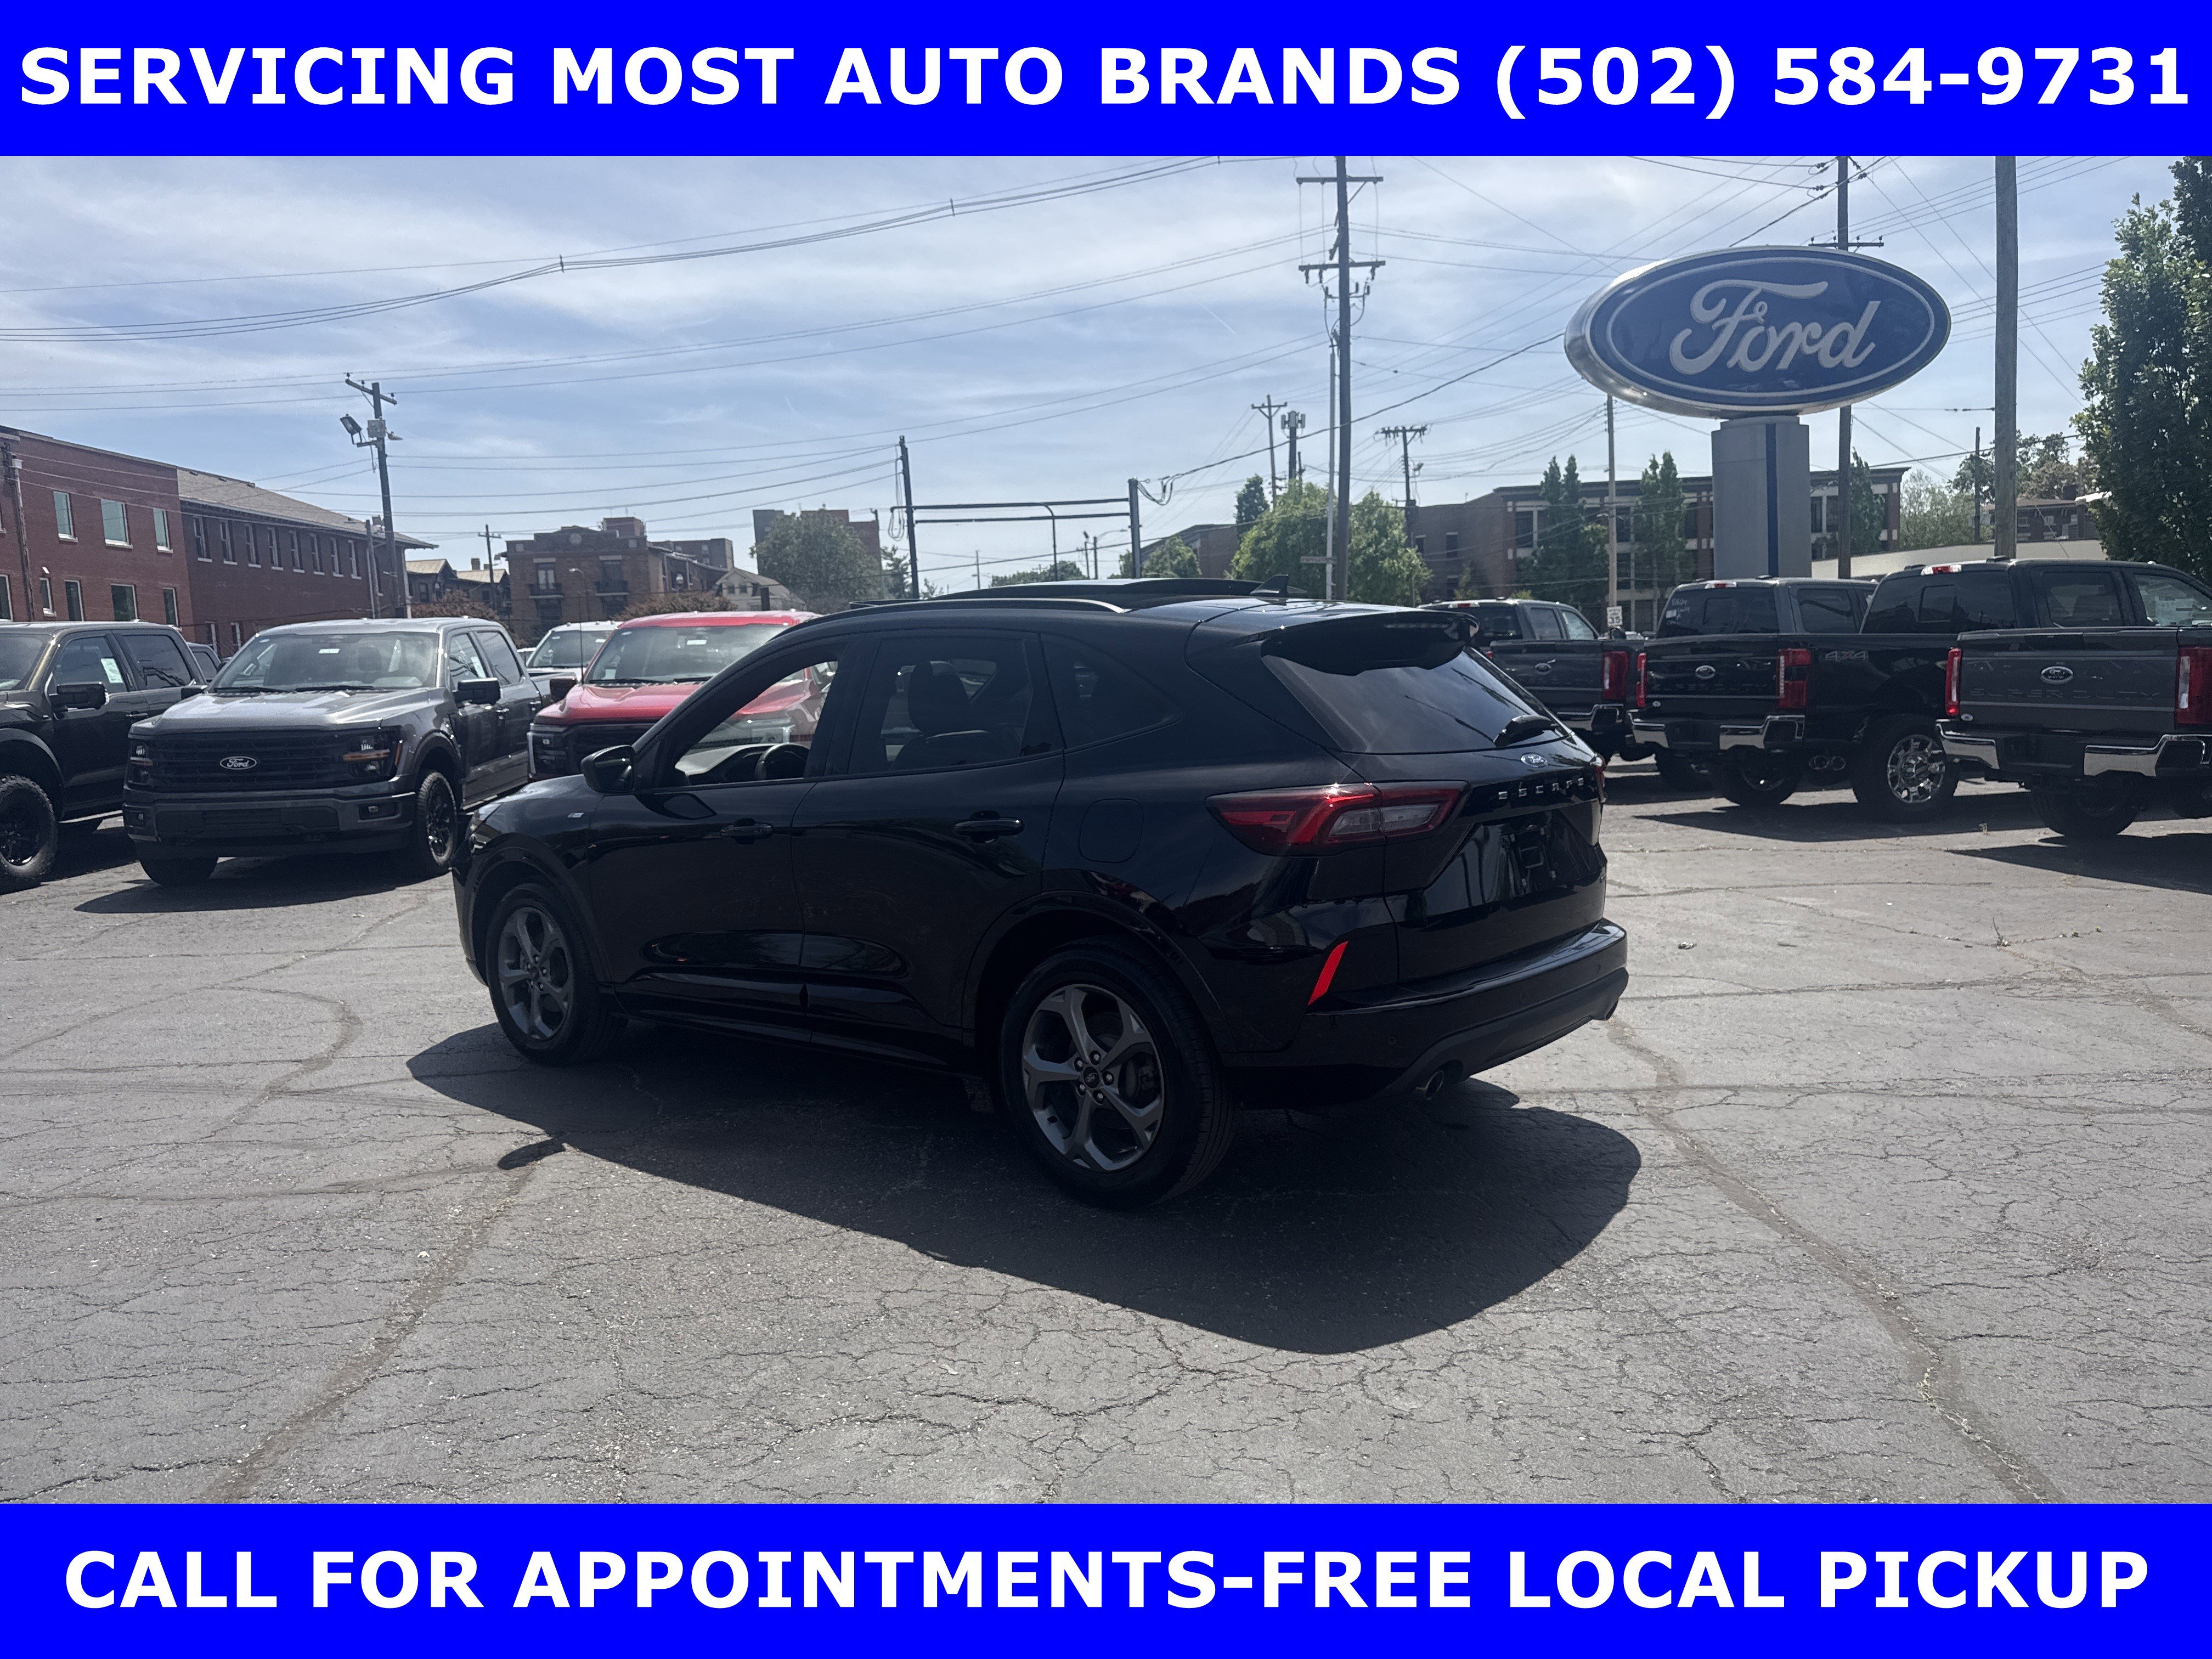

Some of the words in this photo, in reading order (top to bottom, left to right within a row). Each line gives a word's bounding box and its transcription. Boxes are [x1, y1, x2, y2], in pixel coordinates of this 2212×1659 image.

[1668, 279, 1881, 376] Ford
[227, 758, 250, 768] Ford
[1498, 777, 1585, 800] ESCAPE
